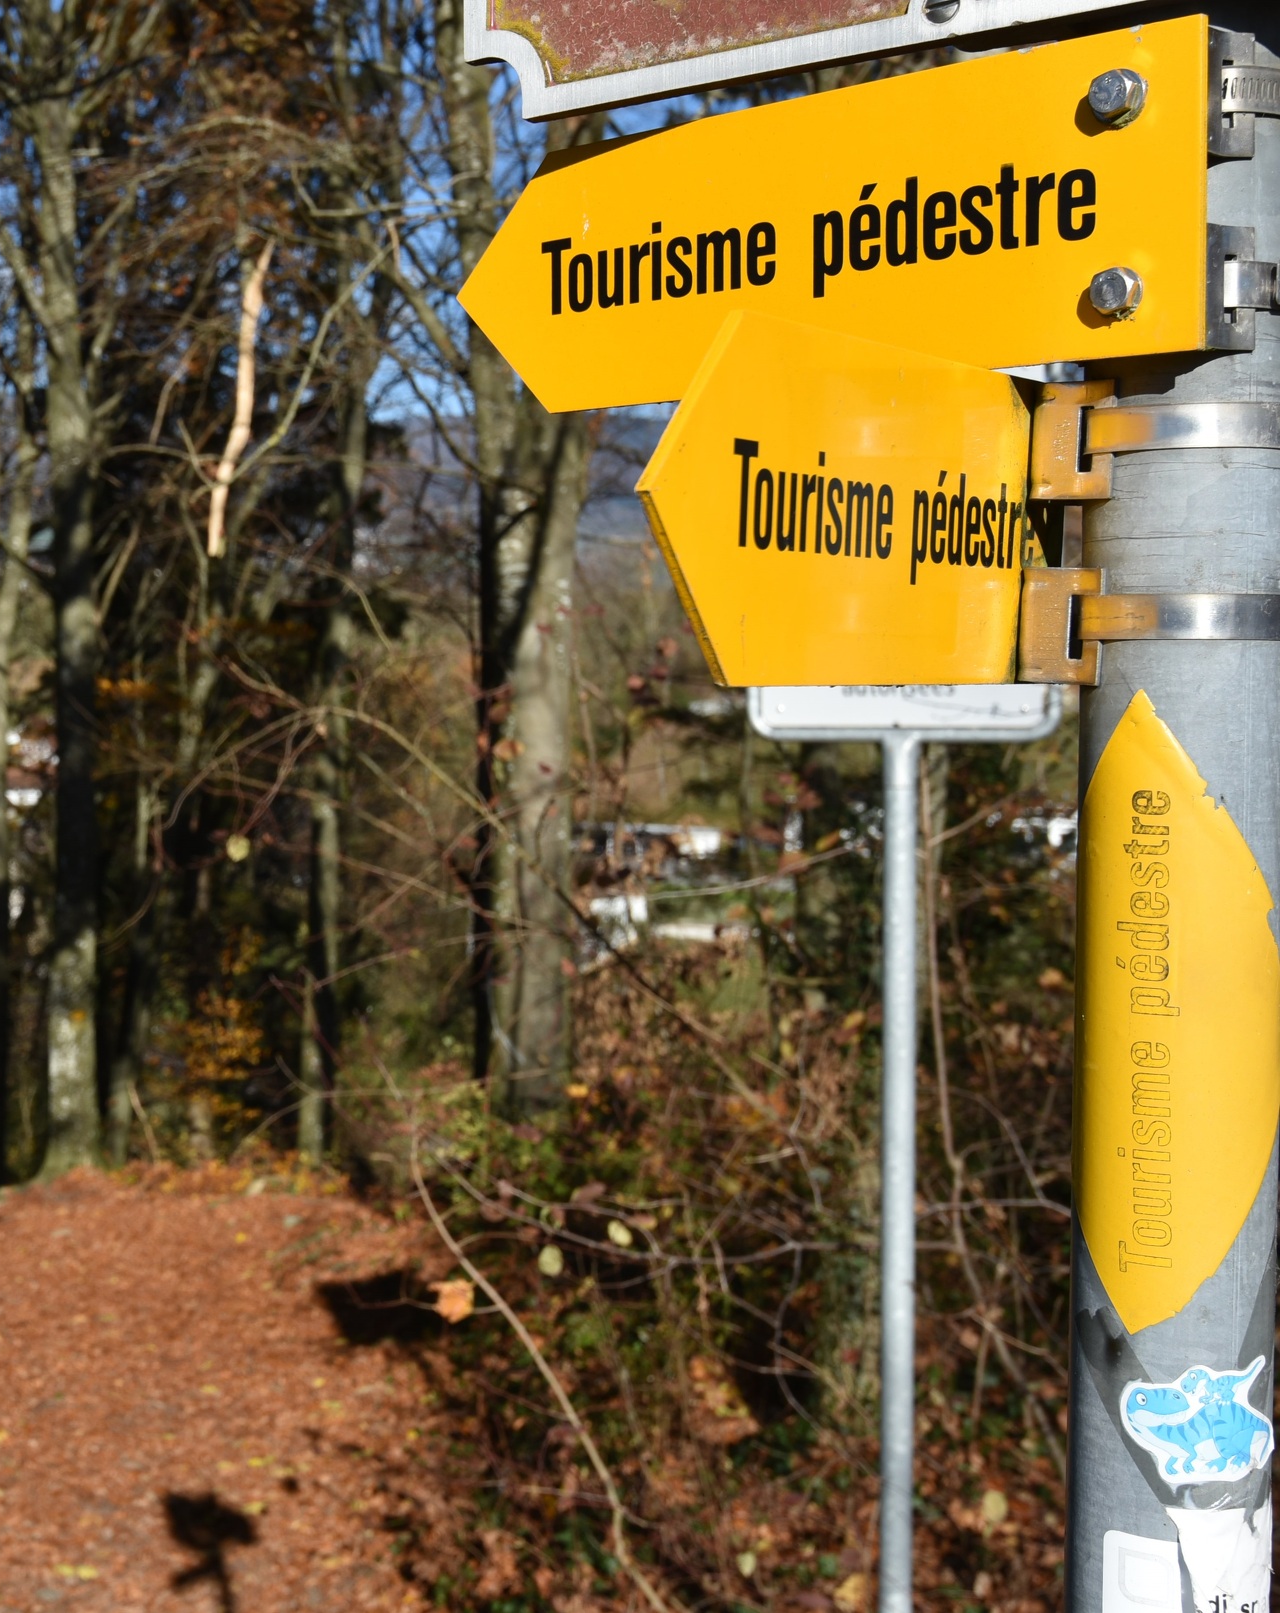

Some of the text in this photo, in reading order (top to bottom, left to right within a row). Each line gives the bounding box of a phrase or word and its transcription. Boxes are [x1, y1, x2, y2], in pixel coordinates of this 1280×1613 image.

[541, 163, 1097, 316] Tourisme pédestre
[733, 437, 894, 560] Tourisme
[1116, 790, 1180, 1273] Tourisme pédestre
